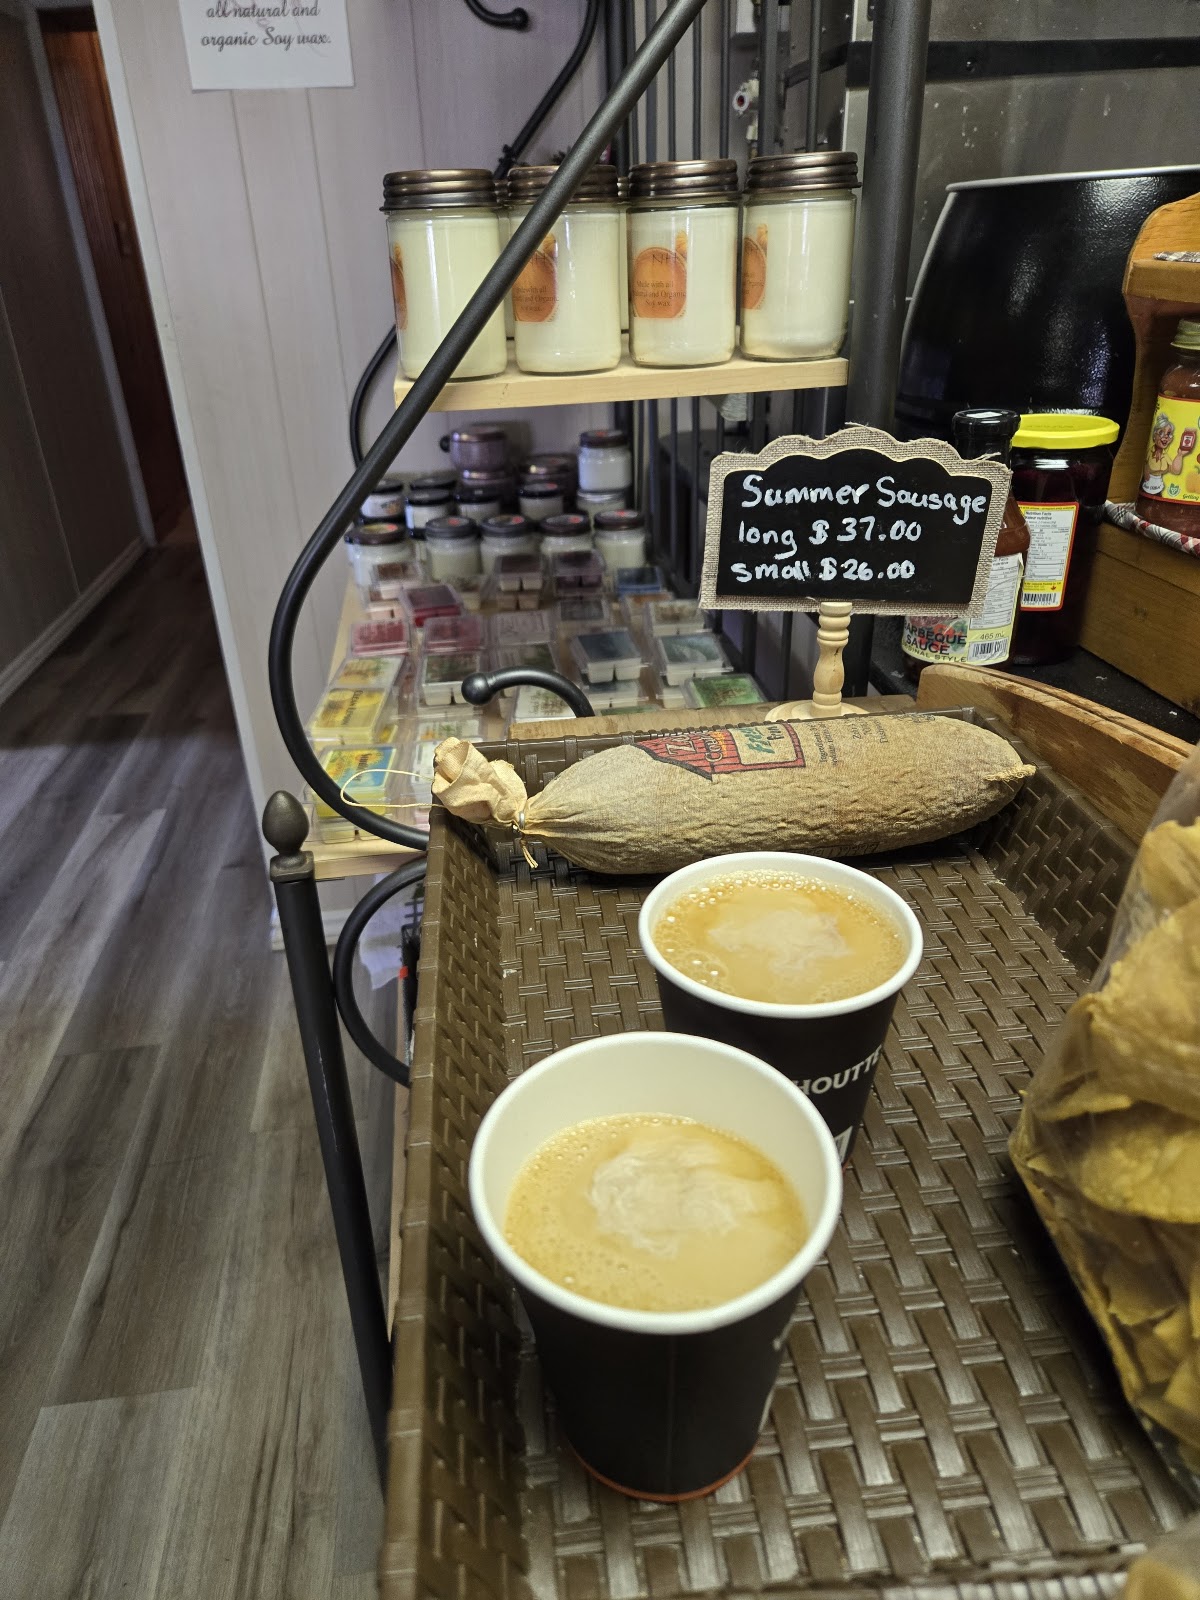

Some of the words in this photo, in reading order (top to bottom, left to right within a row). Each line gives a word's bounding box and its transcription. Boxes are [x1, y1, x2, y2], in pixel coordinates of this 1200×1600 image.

[206, 0, 231, 18] all
[233, 0, 290, 18] natural
[291, 0, 321, 17] and
[201, 31, 258, 52] organic
[262, 26, 295, 51] Soy
[296, 33, 332, 46] wax.
[741, 474, 869, 508] Summer
[876, 475, 987, 526] Sausage
[738, 520, 798, 560] long
[730, 560, 811, 582] small
[906, 634, 950, 655] SAUCE
[934, 654, 967, 663] STYLE
